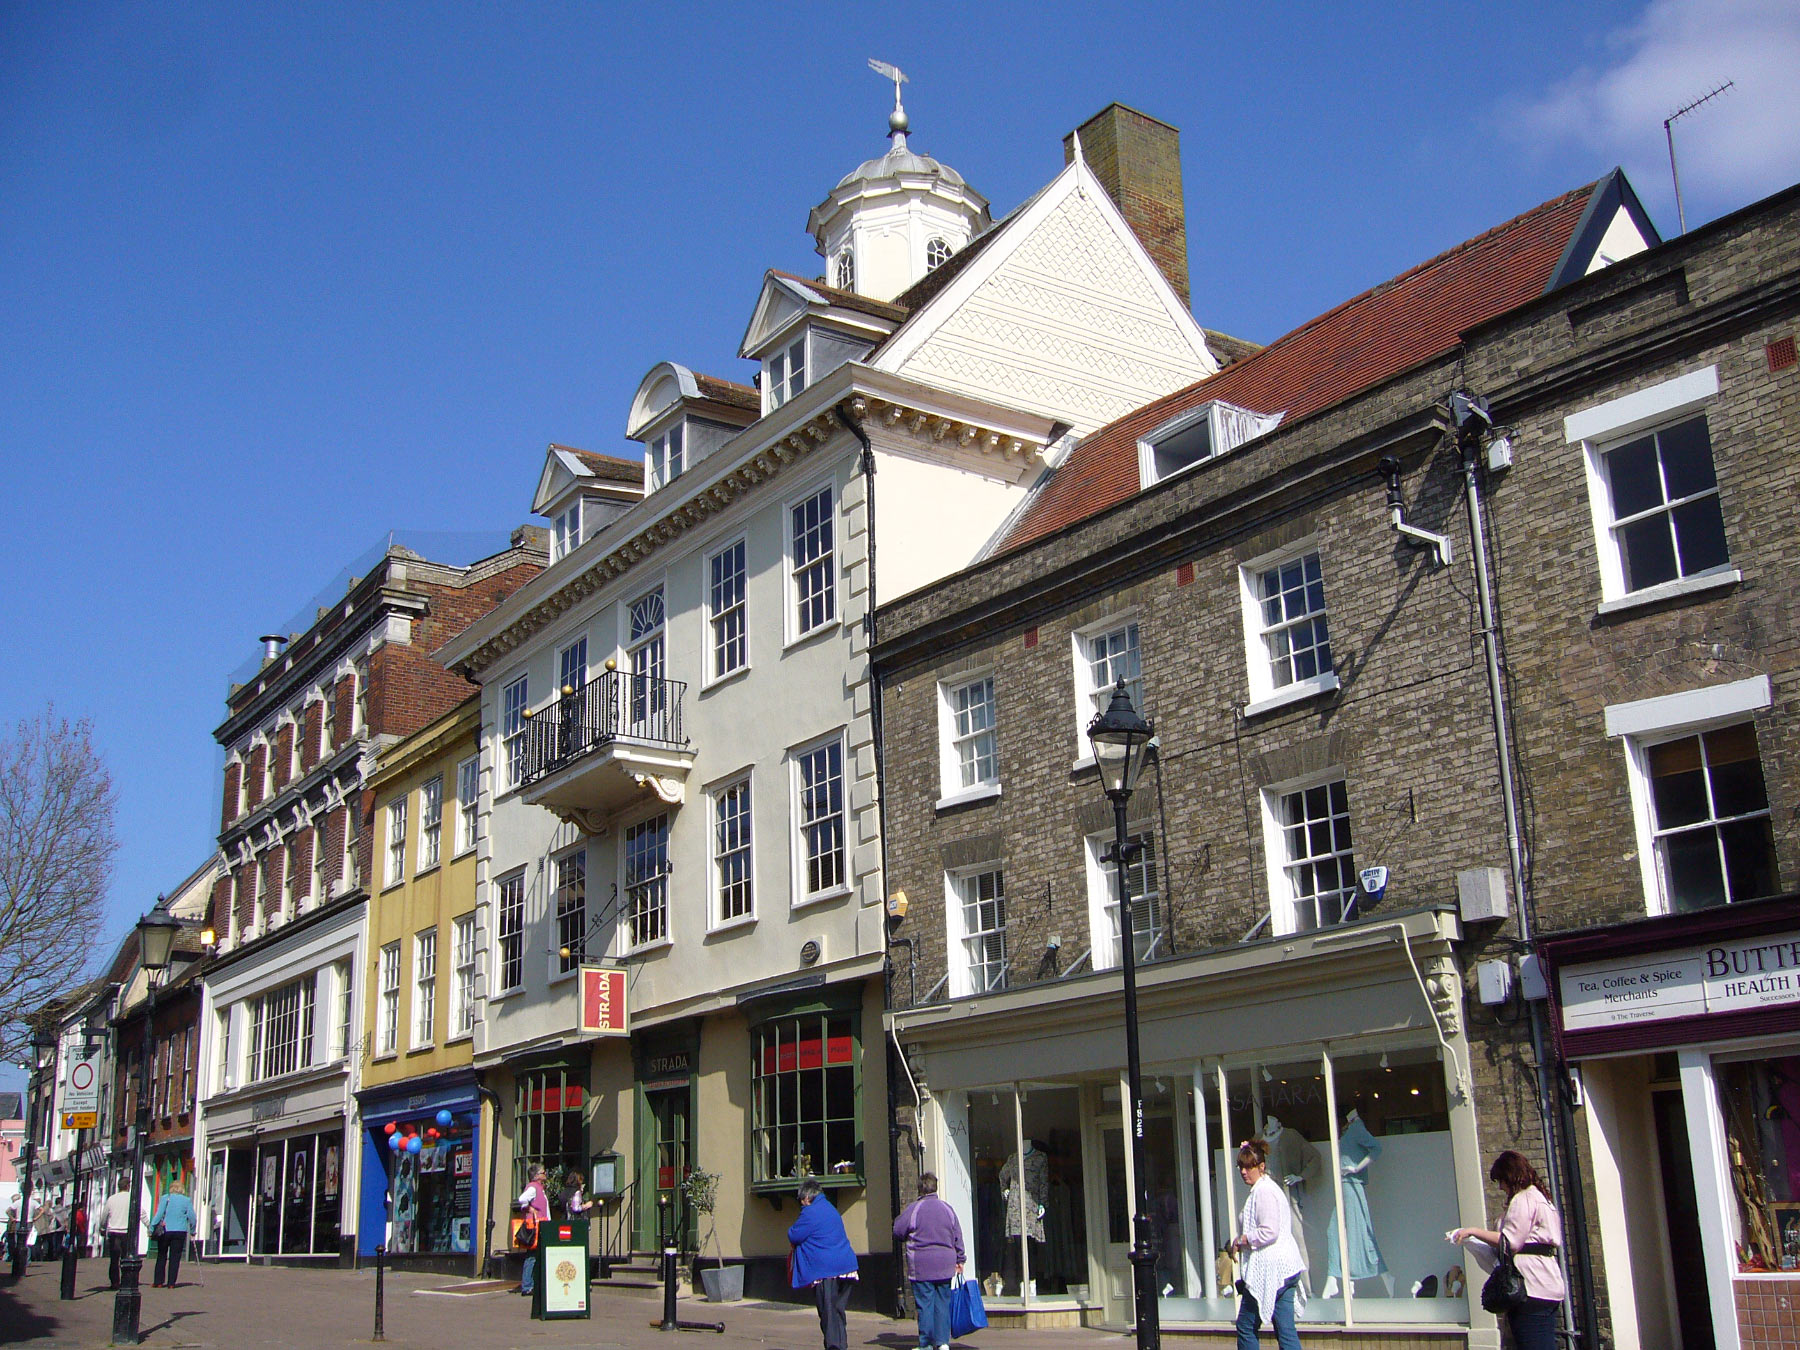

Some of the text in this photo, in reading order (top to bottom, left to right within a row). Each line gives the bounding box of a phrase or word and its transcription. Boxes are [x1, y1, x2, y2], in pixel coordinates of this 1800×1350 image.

[1578, 969, 1683, 993] Tea, Coffee & Spice
[1724, 976, 1791, 997] HEALTH
[599, 972, 611, 1030] STRADA
[1604, 988, 1658, 1004] Merchants
[651, 1055, 688, 1073] STRADA
[1232, 1083, 1322, 1111] SAHARA
